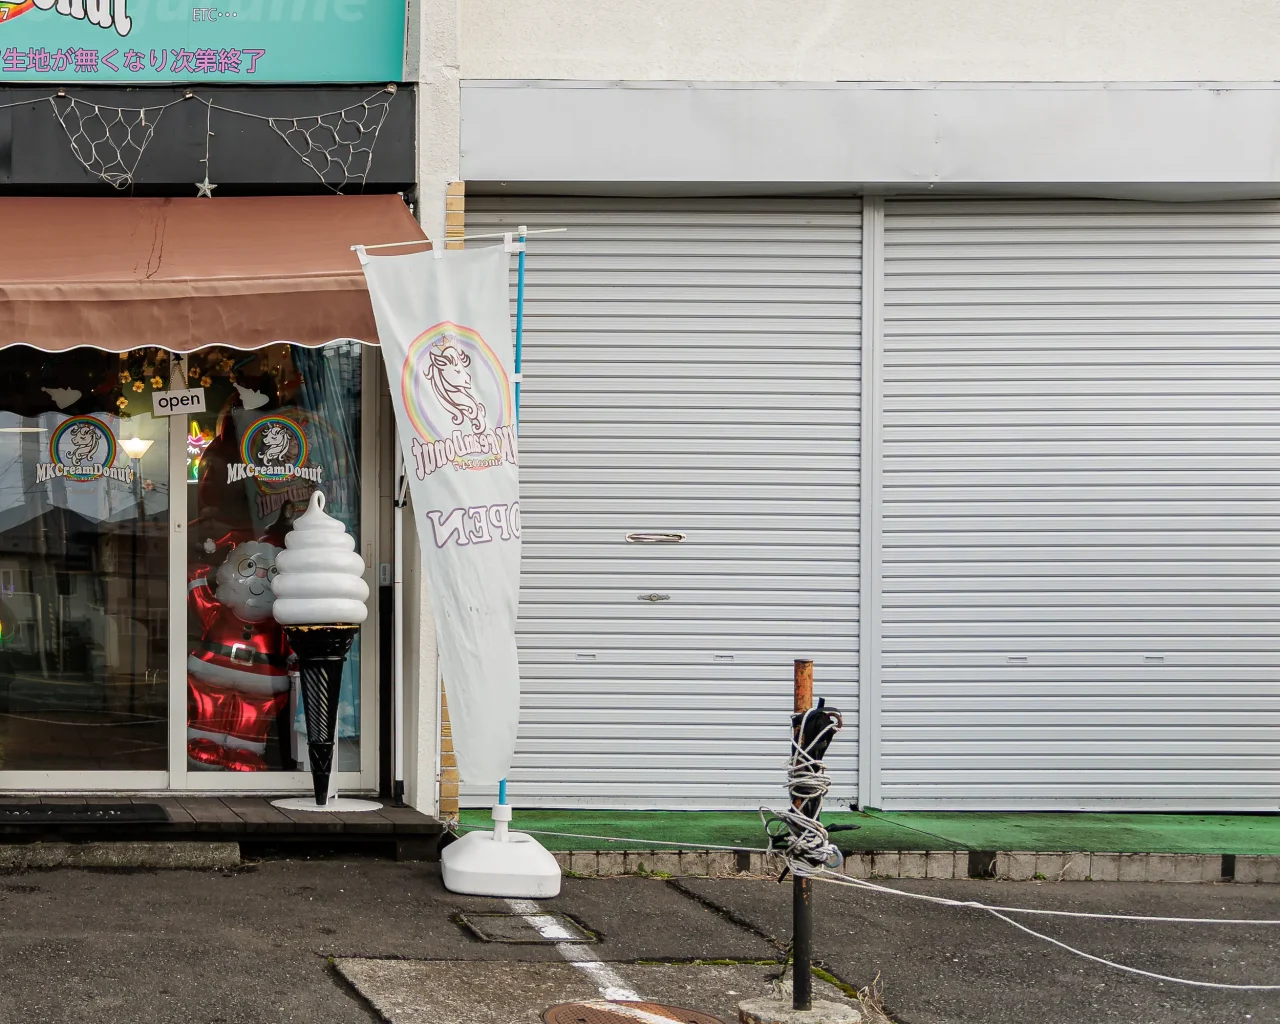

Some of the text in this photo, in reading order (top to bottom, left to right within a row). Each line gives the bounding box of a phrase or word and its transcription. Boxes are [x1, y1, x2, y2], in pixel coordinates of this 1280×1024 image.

[158, 394, 200, 411] open
[35, 463, 132, 484] MKCreamDonut
[226, 463, 322, 484] MKCreamDonut
